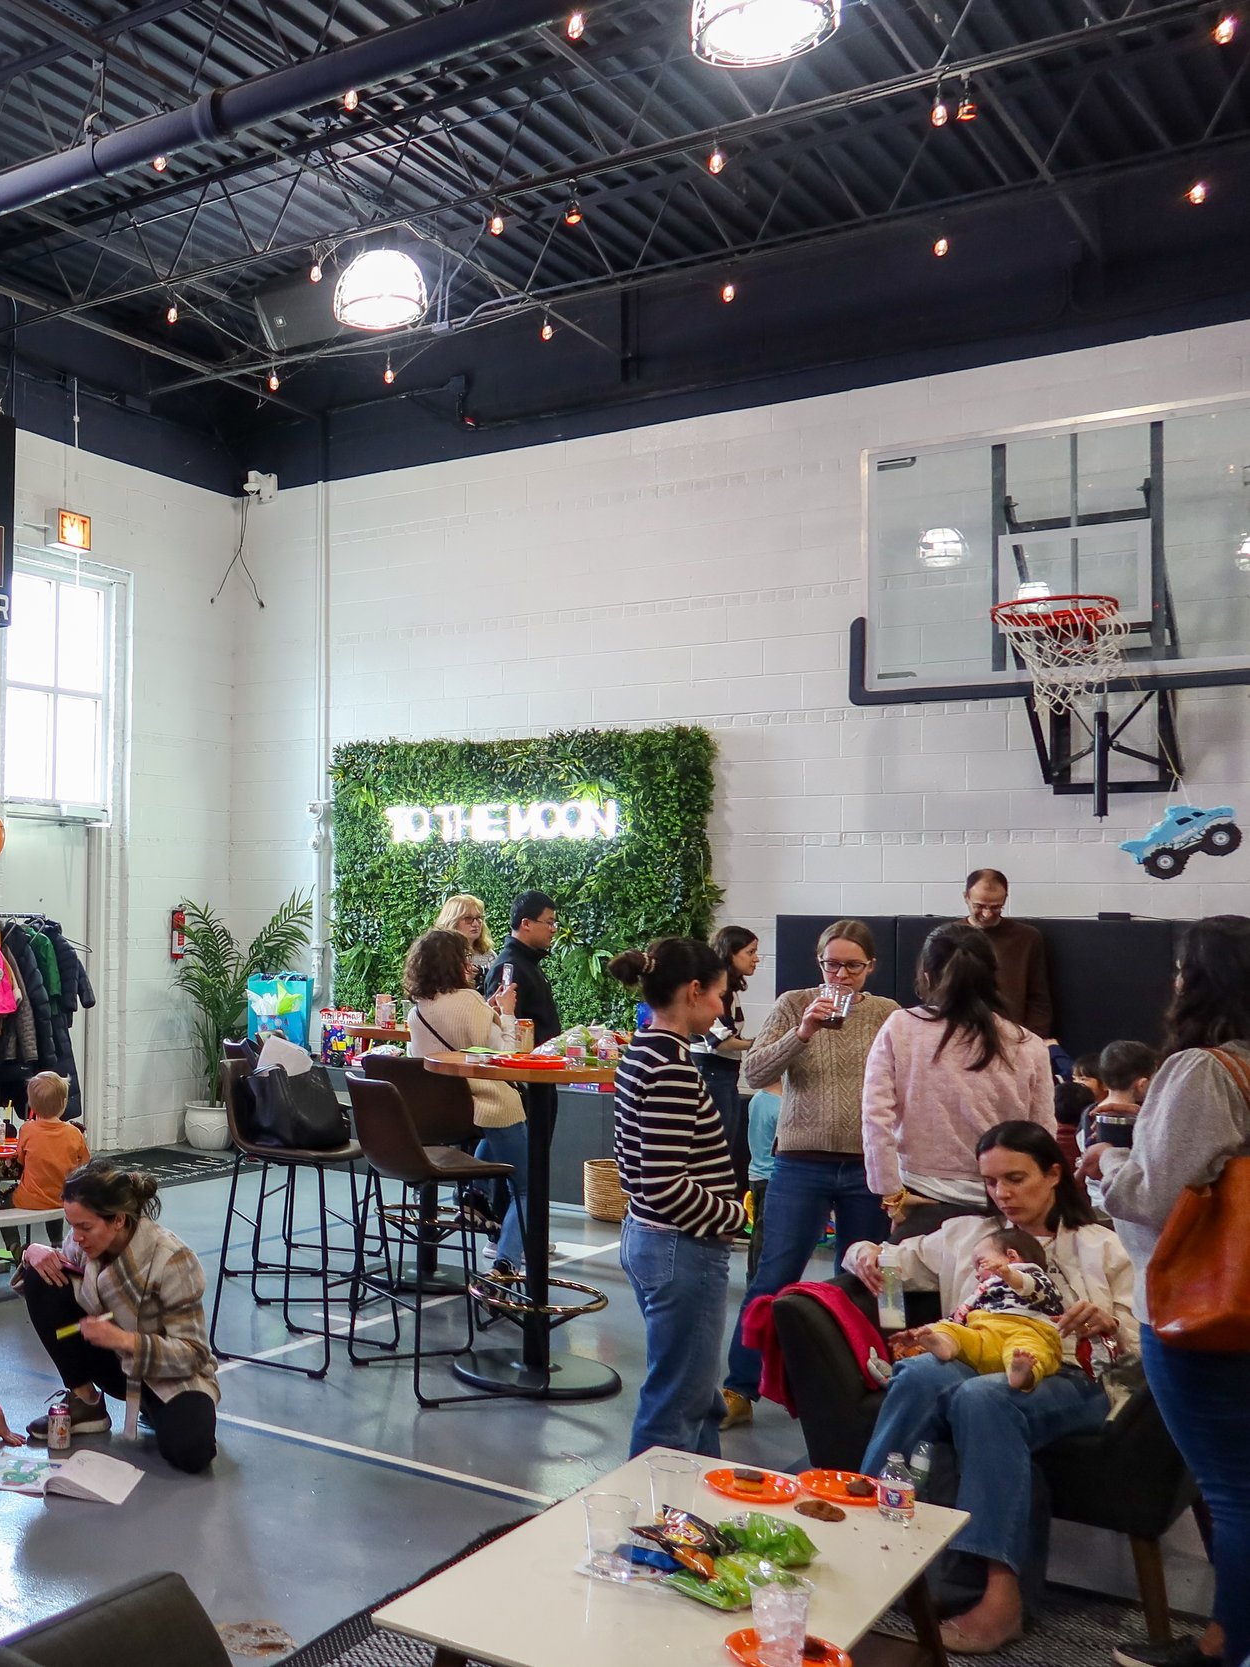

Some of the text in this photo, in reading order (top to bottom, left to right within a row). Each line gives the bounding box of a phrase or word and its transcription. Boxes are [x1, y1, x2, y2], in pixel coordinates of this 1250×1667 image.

[385, 799, 617, 842] TO THE MOON
